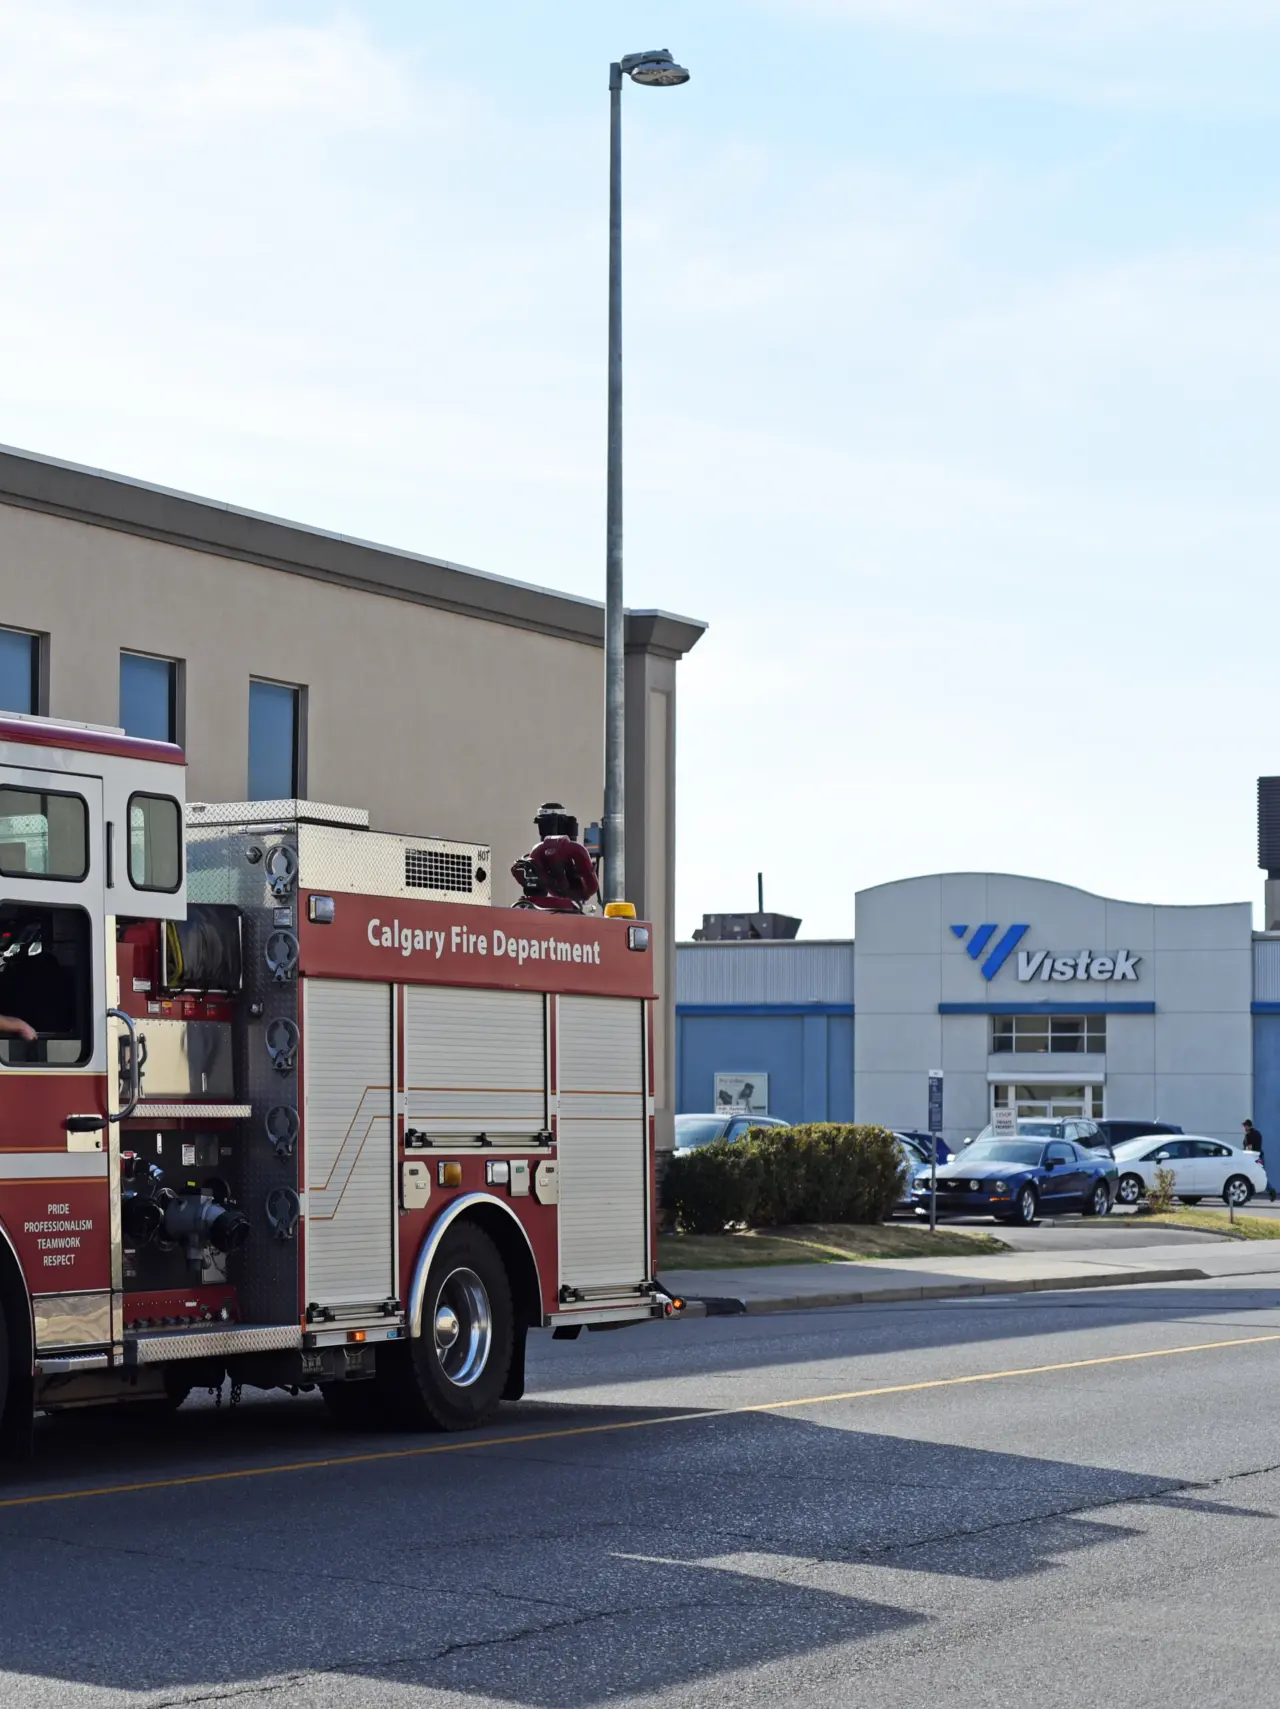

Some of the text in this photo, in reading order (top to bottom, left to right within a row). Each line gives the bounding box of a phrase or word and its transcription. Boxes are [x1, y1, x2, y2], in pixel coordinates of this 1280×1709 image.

[367, 918, 601, 965] Calgary Fire Department
[1017, 949, 1142, 982] Vistek
[47, 1203, 70, 1215] PRIDE
[24, 1219, 93, 1233] PROFESSIONALISM
[37, 1237, 81, 1250] TEAMWORK
[43, 1254, 76, 1267] RESPECT
